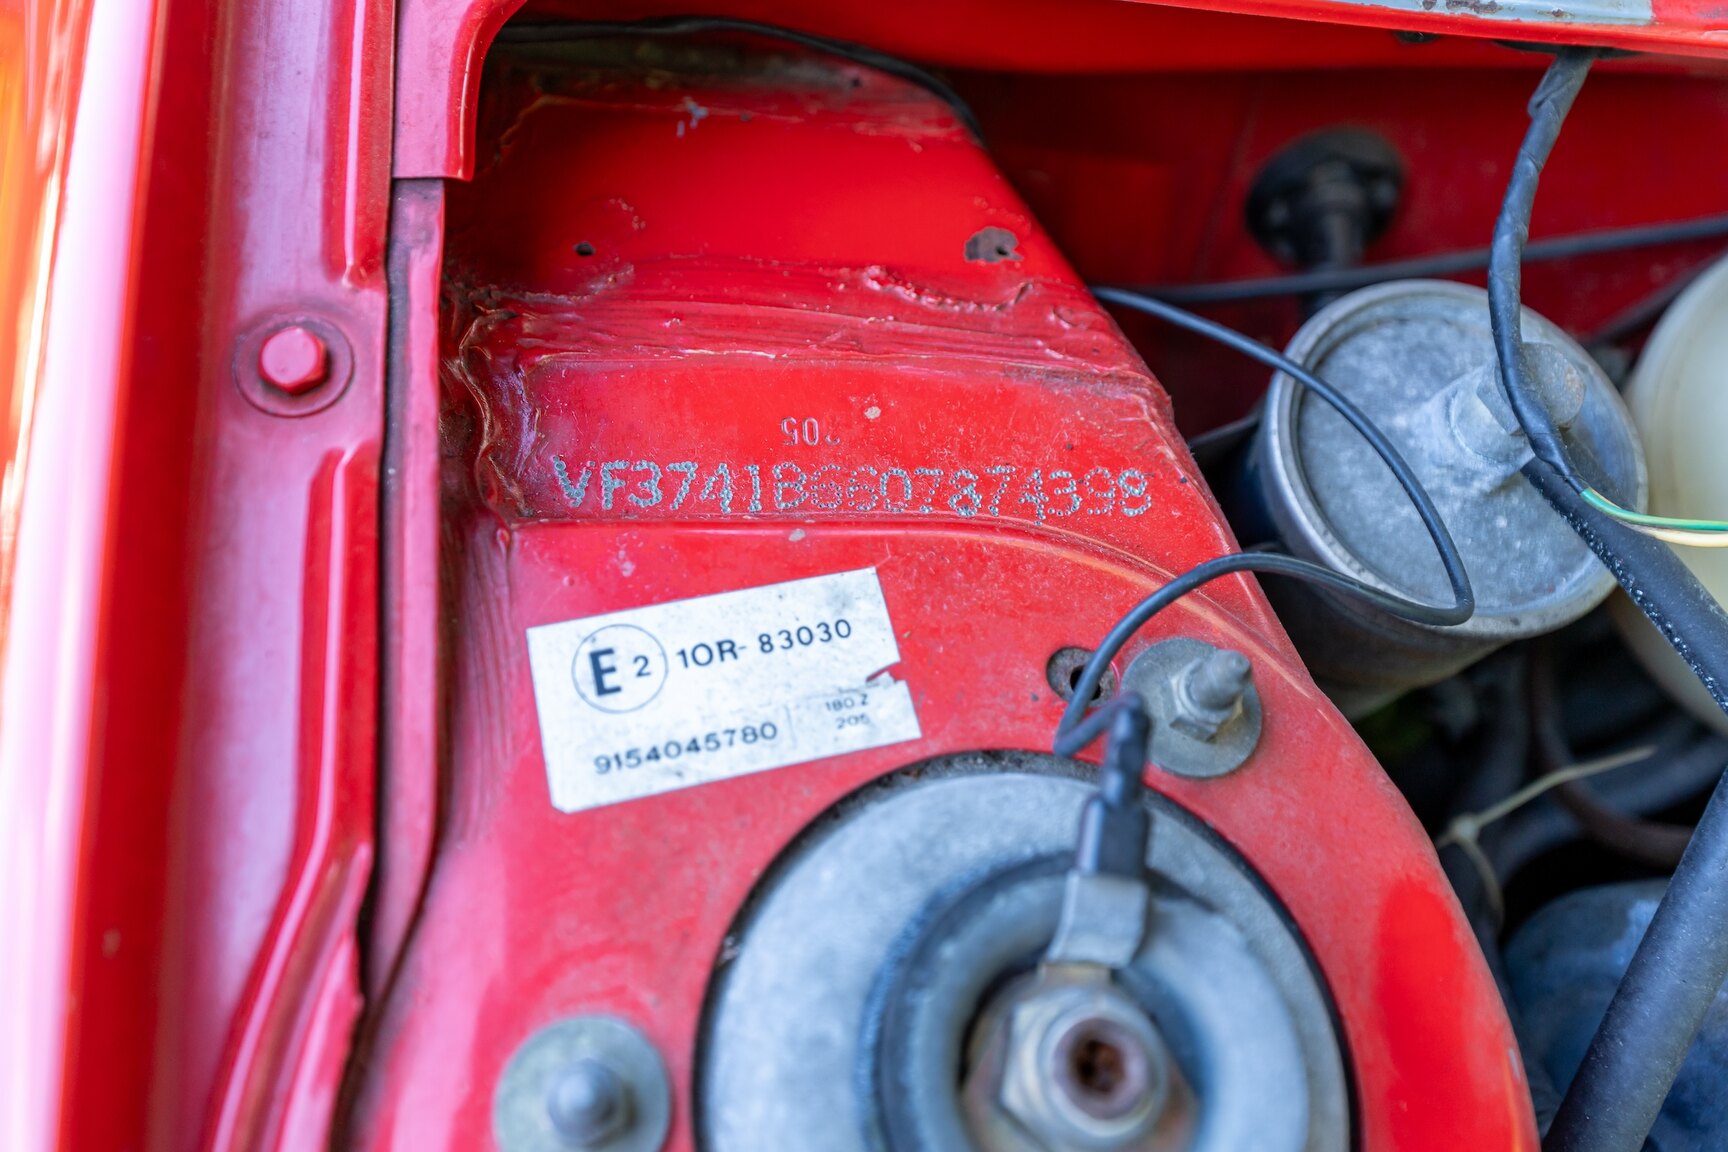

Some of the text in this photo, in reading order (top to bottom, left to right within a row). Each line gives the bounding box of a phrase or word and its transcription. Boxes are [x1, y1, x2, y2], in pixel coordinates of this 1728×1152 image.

[757, 618, 853, 654] 83030
[589, 647, 652, 698] E 2
[594, 720, 779, 775] 9154045780
